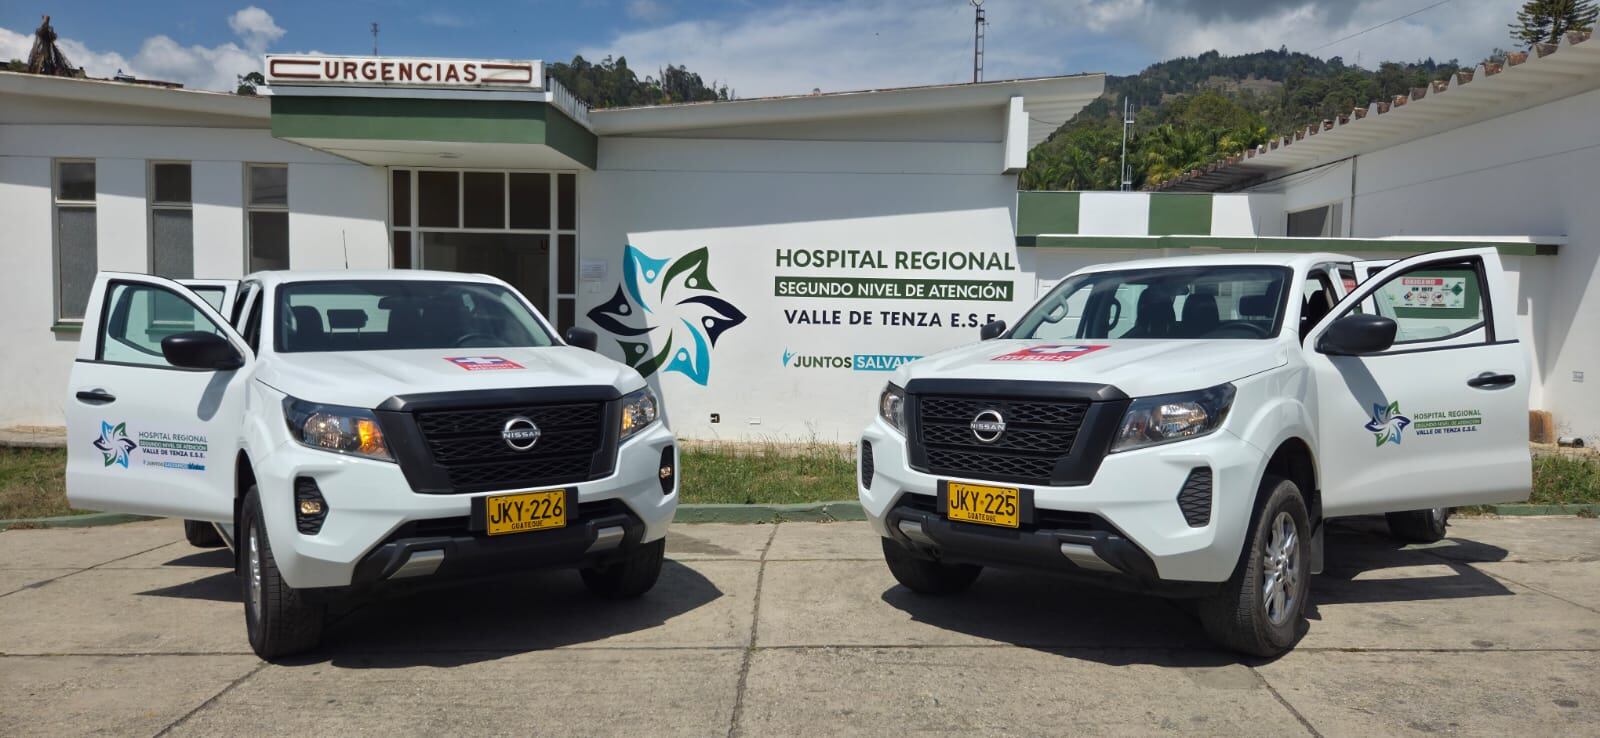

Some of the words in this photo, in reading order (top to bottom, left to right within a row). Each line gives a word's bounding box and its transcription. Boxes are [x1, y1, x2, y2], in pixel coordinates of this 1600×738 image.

[325, 61, 477, 82] URGENCIAS
[775, 248, 889, 269] HOSPITAL
[894, 250, 1016, 271] REGIONAL
[778, 281, 854, 296] SEGUNDO
[857, 282, 902, 297] NIVEL
[904, 283, 925, 297] DE
[928, 282, 1008, 299] ATENCIÓN
[783, 309, 842, 325] VALLE
[848, 310, 873, 325] DE
[880, 311, 943, 327] TENZA
[950, 313, 997, 328] E.S.E
[793, 355, 853, 368] JUNTOS
[1414, 412, 1446, 420] HOSPITAL
[1448, 409, 1481, 417] REGIONAL
[970, 423, 1005, 431] NISSAN
[139, 432, 171, 440] HOSPITAL
[173, 434, 208, 442] REGIONAL
[503, 430, 541, 439] NISSAN
